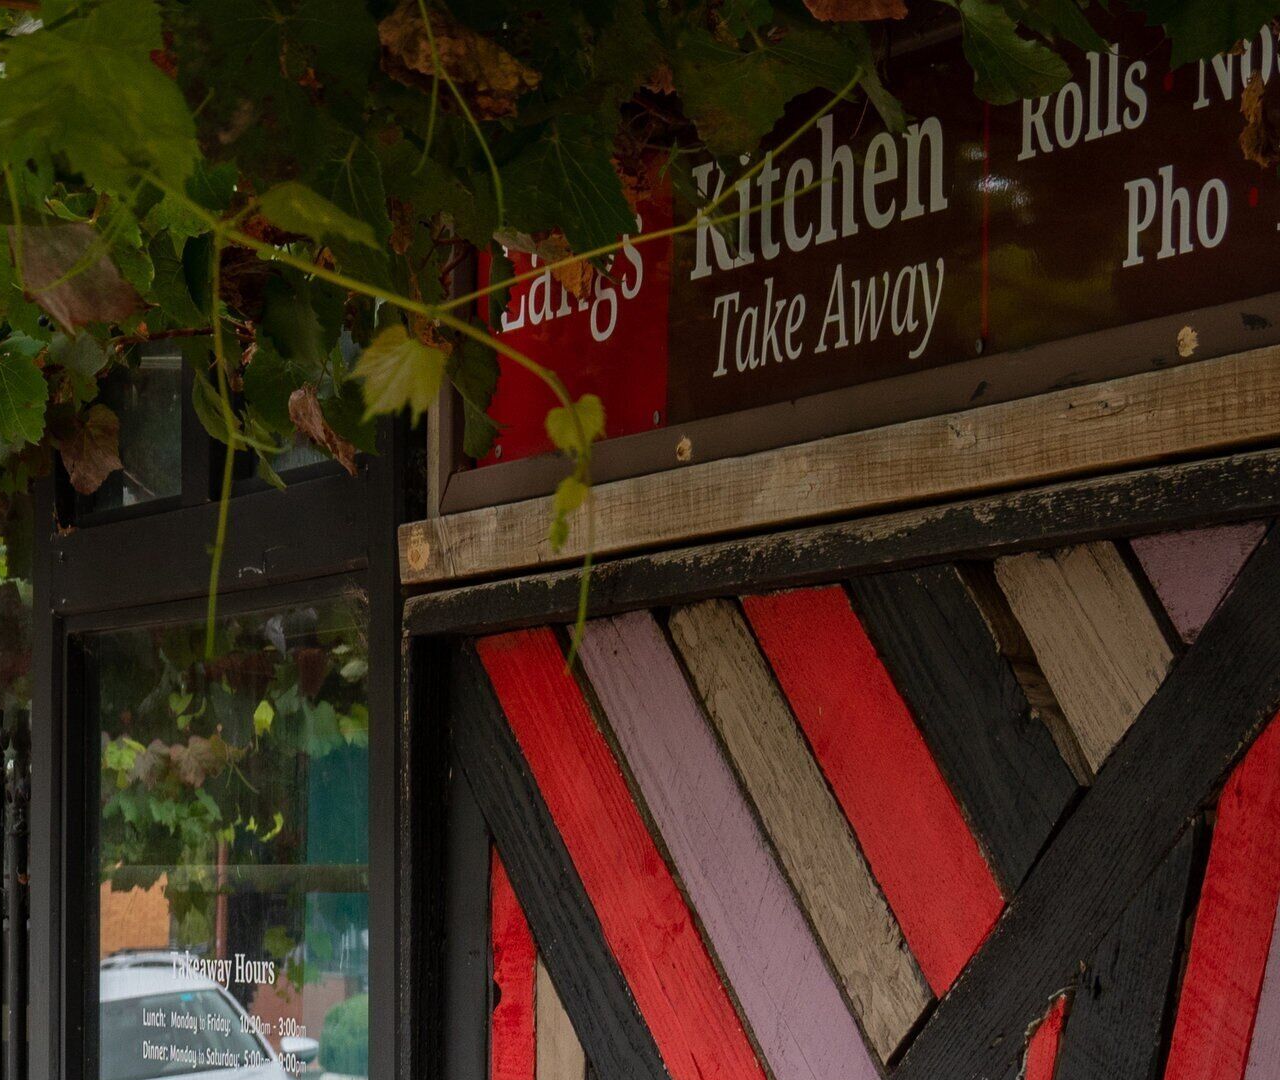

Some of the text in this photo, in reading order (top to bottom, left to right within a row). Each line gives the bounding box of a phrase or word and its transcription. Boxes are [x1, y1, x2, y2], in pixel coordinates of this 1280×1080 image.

[1017, 24, 1280, 162] Rolls No
[690, 113, 948, 281] Kitchen
[1122, 165, 1229, 268] Pho
[713, 257, 946, 379] Take Away
[171, 951, 275, 990] Takeaway Hours
[143, 1008, 166, 1027] Lunch:
[171, 1011, 198, 1034] Monday
[207, 1013, 231, 1037] Friday:
[278, 1017, 307, 1038] 3:00pm
[143, 1041, 169, 1061] Dinner:
[170, 1044, 198, 1068] Monday
[206, 1048, 240, 1071] Saturday:
